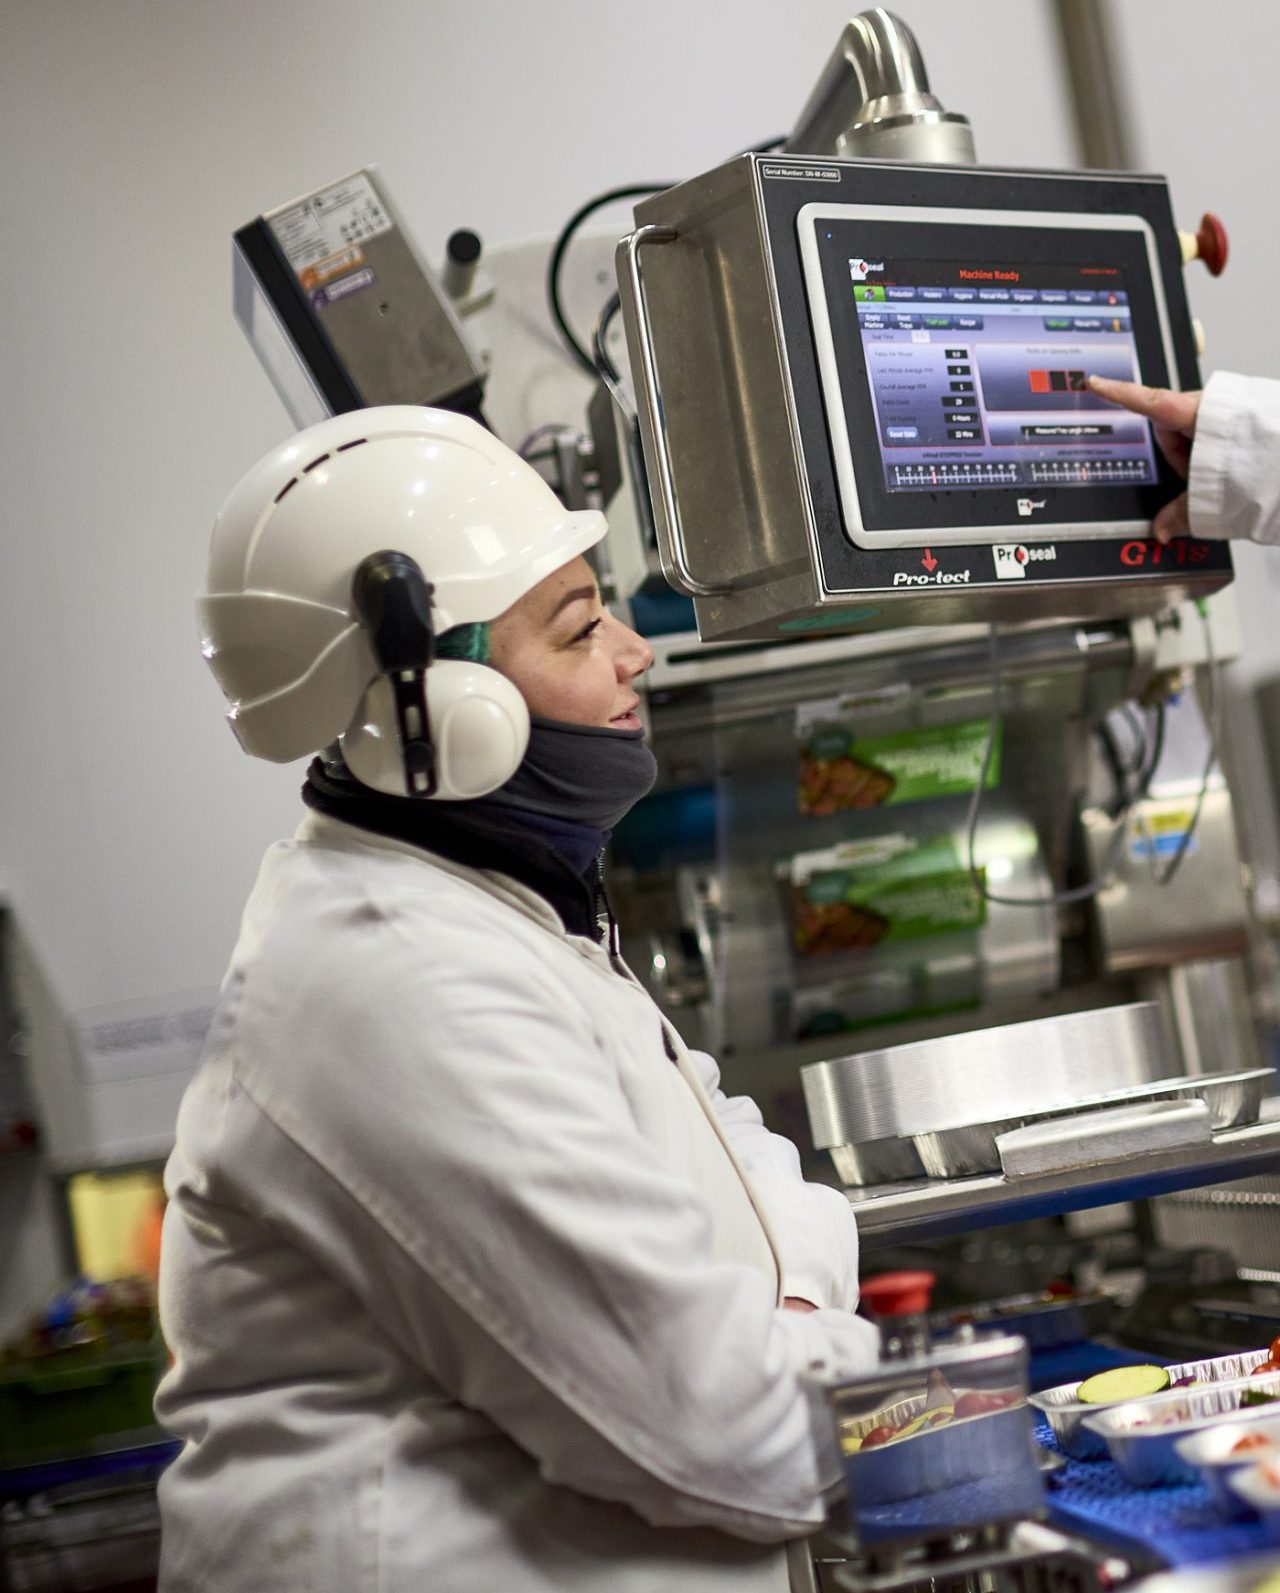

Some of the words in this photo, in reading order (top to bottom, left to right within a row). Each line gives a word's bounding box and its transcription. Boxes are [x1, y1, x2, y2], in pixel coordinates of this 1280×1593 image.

[959, 269, 993, 280] Machine
[995, 271, 1020, 282] Ready
[893, 570, 971, 585] Pro-tect
